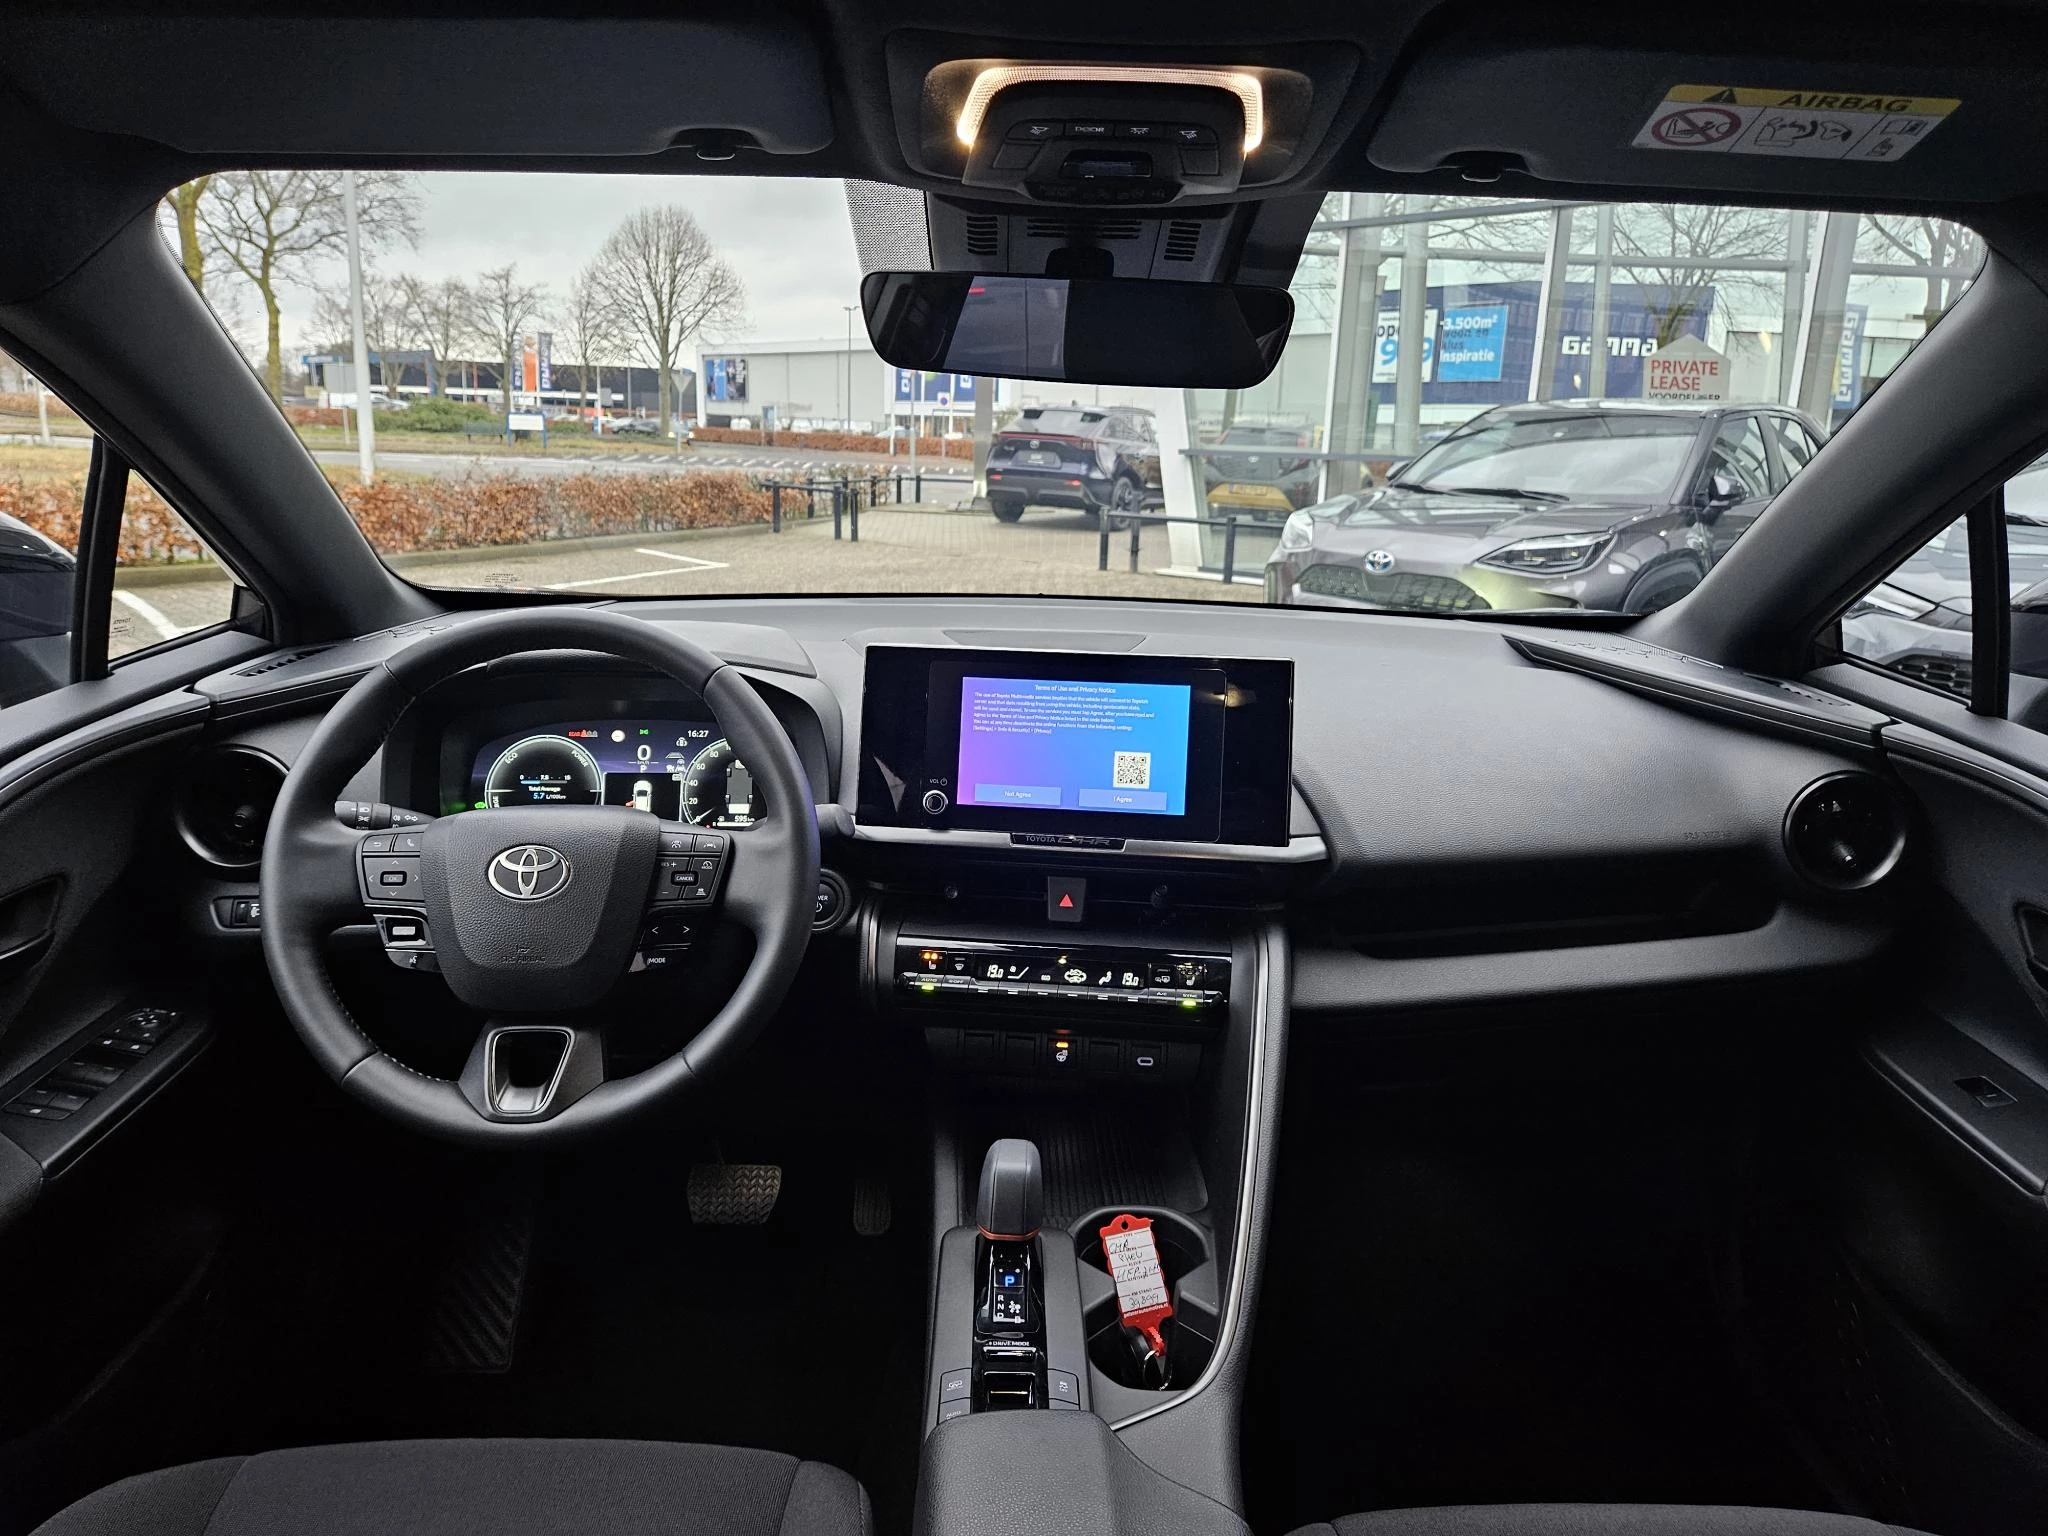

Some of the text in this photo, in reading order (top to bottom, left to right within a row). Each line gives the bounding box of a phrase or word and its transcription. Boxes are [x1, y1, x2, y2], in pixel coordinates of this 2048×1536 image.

[1777, 94, 1912, 112] AIRBAG
[1380, 339, 1398, 366] 9
[1651, 360, 1719, 376] PRIVATE
[1650, 376, 1700, 391] LEASE
[504, 752, 518, 764] ECO
[571, 750, 589, 768] POWER
[637, 745, 651, 760] 0
[1005, 1275, 1015, 1287] P
